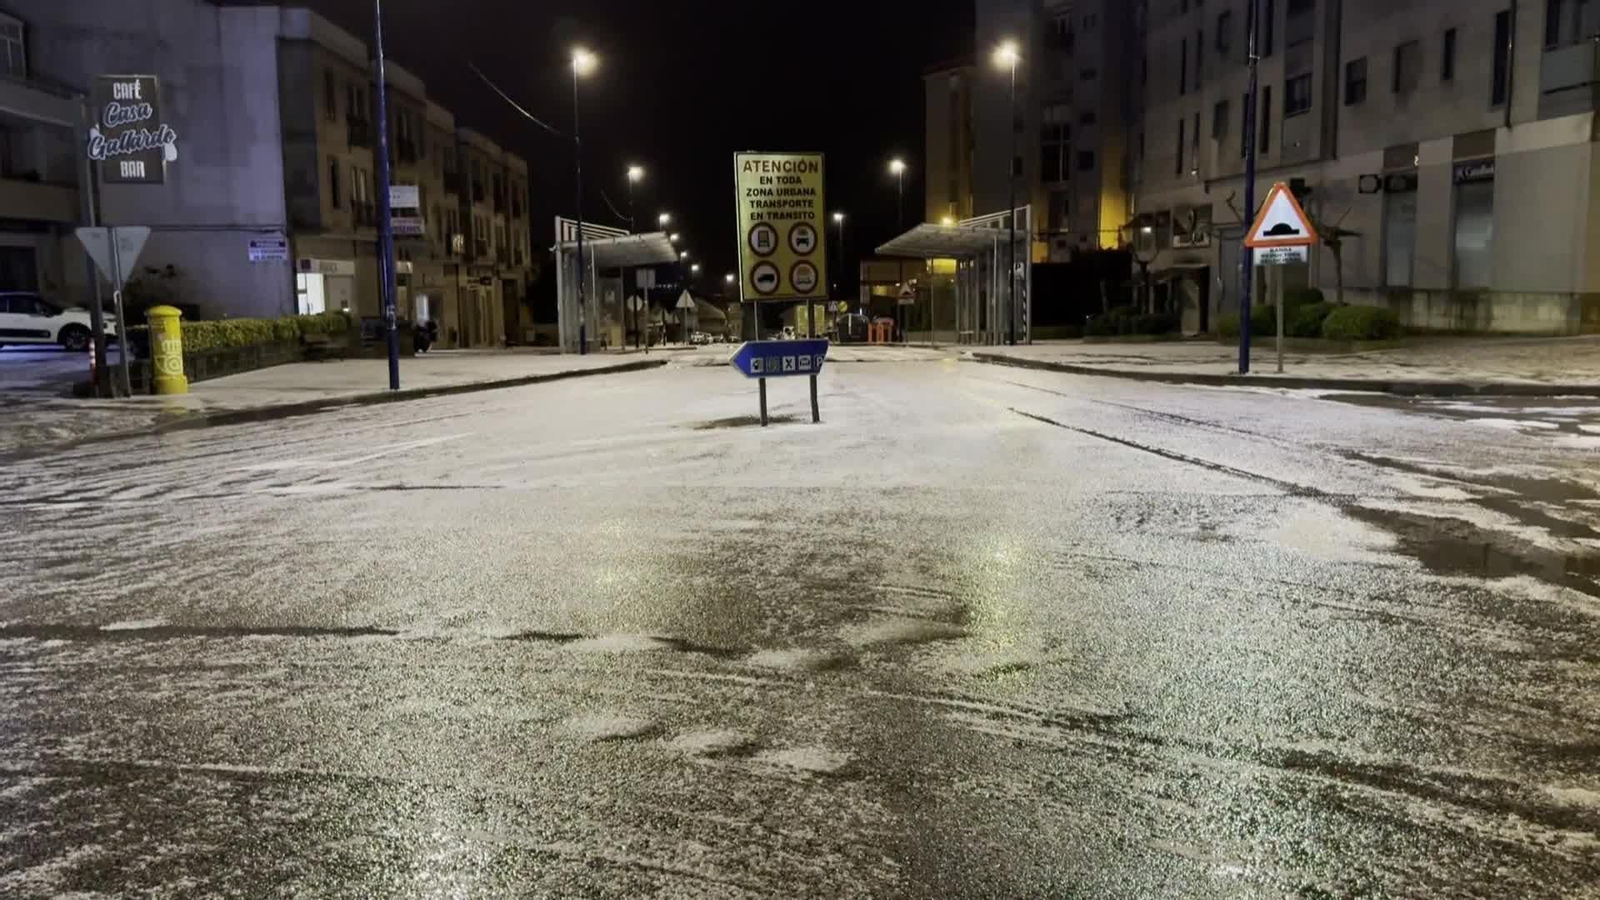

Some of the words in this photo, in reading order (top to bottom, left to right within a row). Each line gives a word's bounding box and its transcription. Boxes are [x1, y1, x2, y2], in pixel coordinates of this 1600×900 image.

[113, 79, 142, 100] CAFÉ
[103, 102, 153, 128] Casa
[88, 124, 177, 160] Gallardo
[120, 161, 145, 178] BAR
[743, 158, 819, 174] ATENCIÓN
[760, 176, 773, 185] EN
[776, 175, 802, 185] TODA
[746, 188, 774, 197] ZONA
[776, 187, 817, 197] URBANA
[749, 200, 814, 209] TRANSPORTE
[750, 212, 764, 221] EN
[766, 211, 815, 220] TRANSITO
